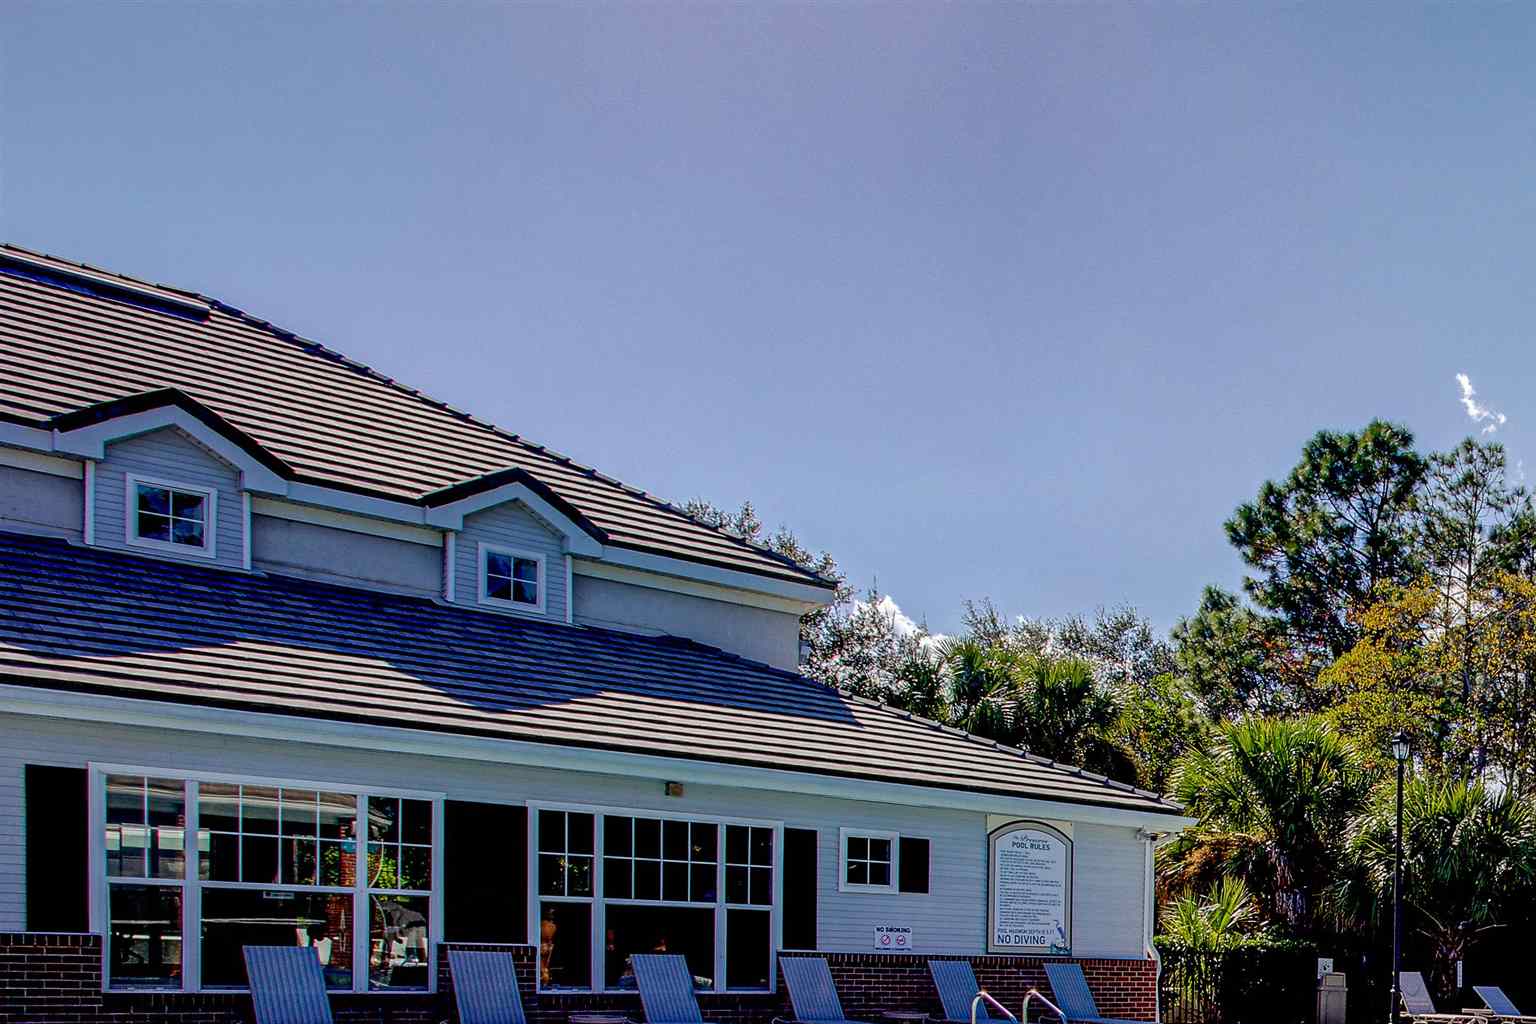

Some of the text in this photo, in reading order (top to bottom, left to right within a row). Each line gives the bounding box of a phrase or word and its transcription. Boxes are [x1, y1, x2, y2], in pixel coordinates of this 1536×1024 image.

[1012, 841, 1050, 850] POOL RULES
[998, 934, 1046, 945] NO DIVING
